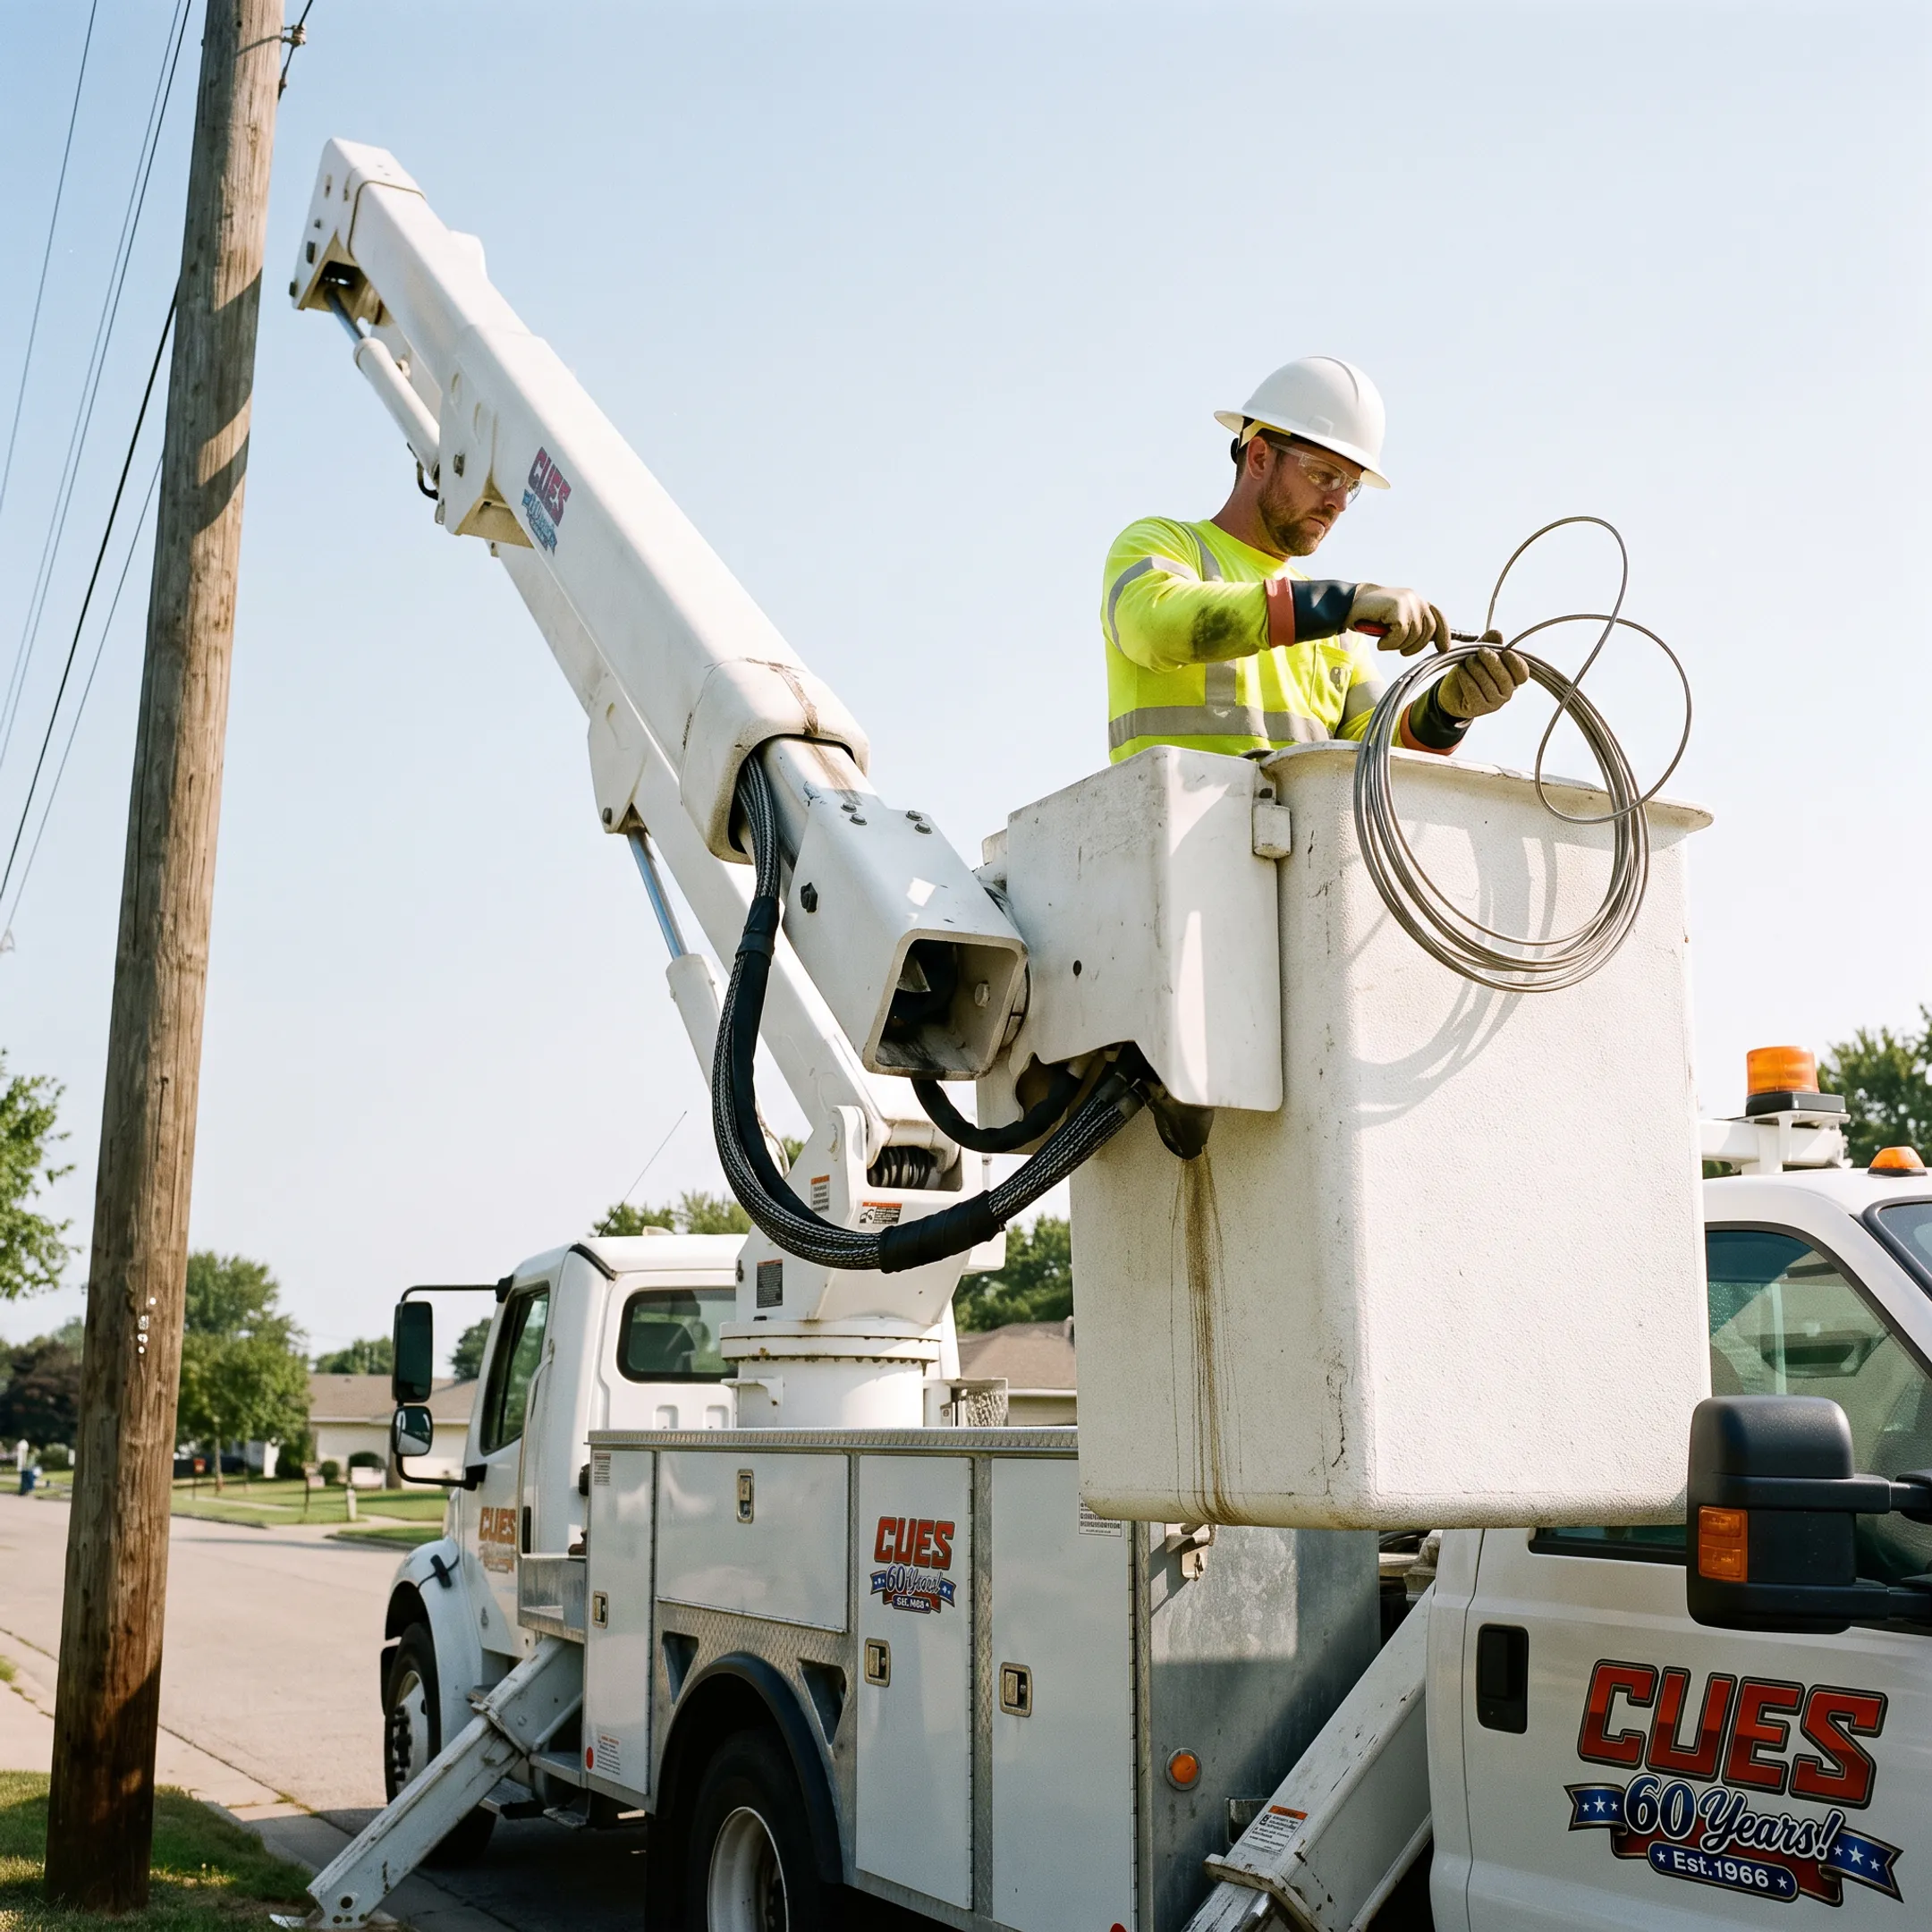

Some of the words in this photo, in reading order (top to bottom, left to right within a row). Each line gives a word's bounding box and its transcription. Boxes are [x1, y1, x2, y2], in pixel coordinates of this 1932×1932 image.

[529, 446, 572, 527] CUES
[874, 1516, 955, 1571] CUES
[886, 1563, 906, 1592] 60
[1578, 1659, 1888, 1809] CUES
[1624, 1773, 1698, 1841] 60
[1699, 1786, 1844, 1860] Years!
